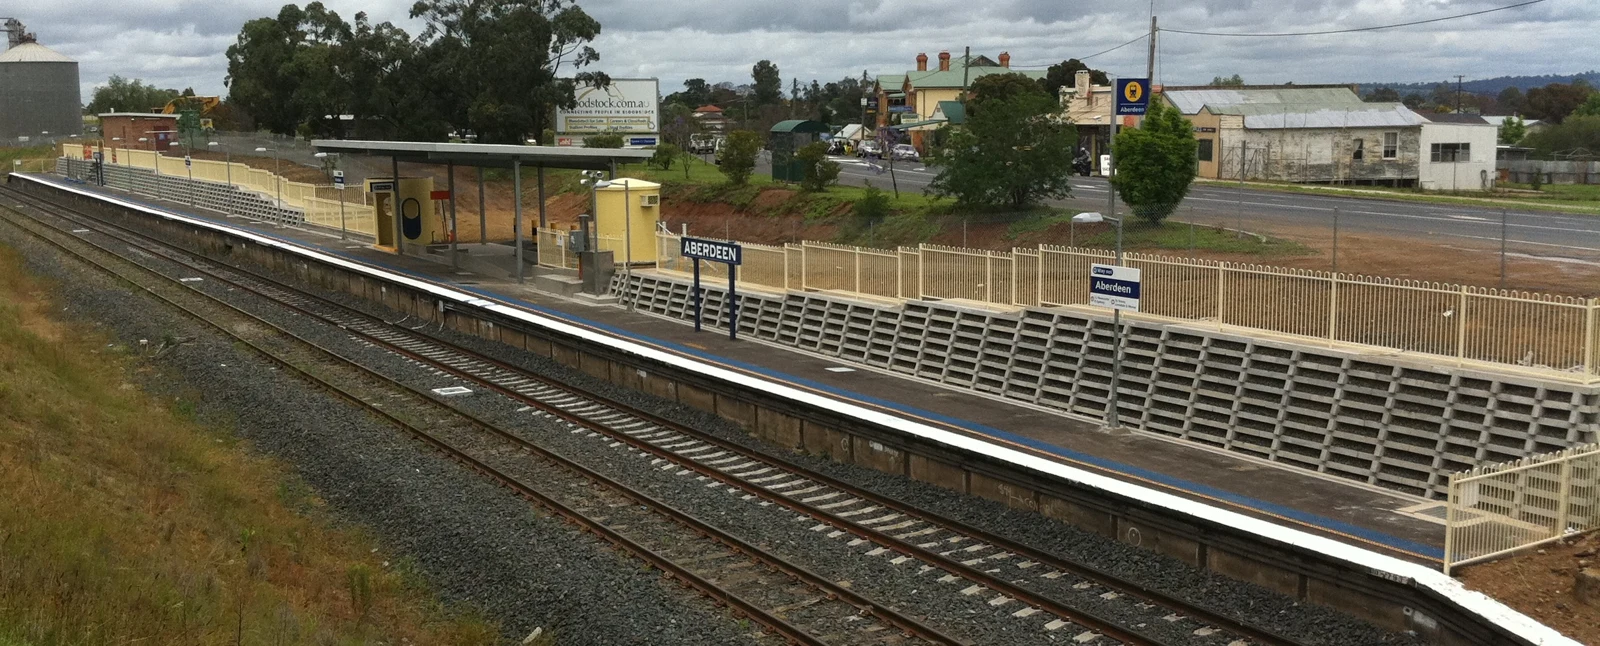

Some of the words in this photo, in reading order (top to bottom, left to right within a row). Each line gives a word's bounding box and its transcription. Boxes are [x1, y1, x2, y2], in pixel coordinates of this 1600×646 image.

[574, 97, 649, 109] odstock.com.au
[684, 241, 736, 261] ABERDEEN
[1095, 281, 1131, 294] Aberdeen
